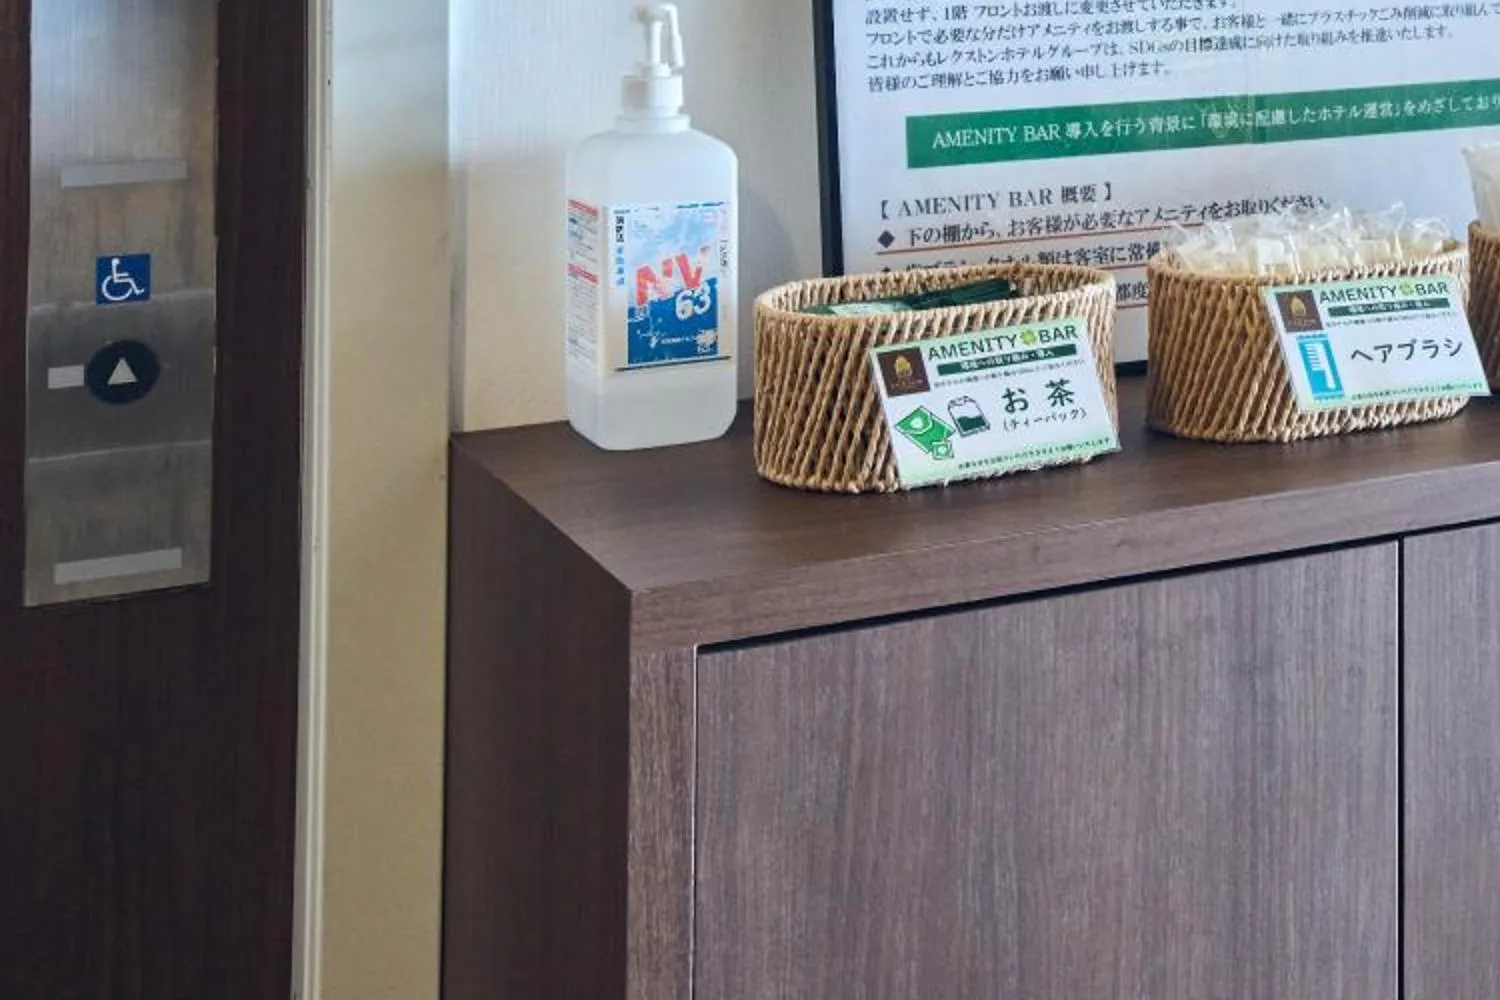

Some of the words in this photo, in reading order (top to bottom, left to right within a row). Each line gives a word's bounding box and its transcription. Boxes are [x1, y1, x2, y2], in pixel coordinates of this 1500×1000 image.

[932, 125, 1018, 150] AMENITY
[1024, 123, 1060, 142] BAR
[1009, 188, 1053, 208] BAR
[1320, 285, 1397, 304] AMENITY
[1414, 281, 1450, 297] BAR
[927, 333, 1018, 361] AMENITY
[1039, 325, 1079, 343] BAR
[1351, 337, 1463, 364] ヘアブラシ
